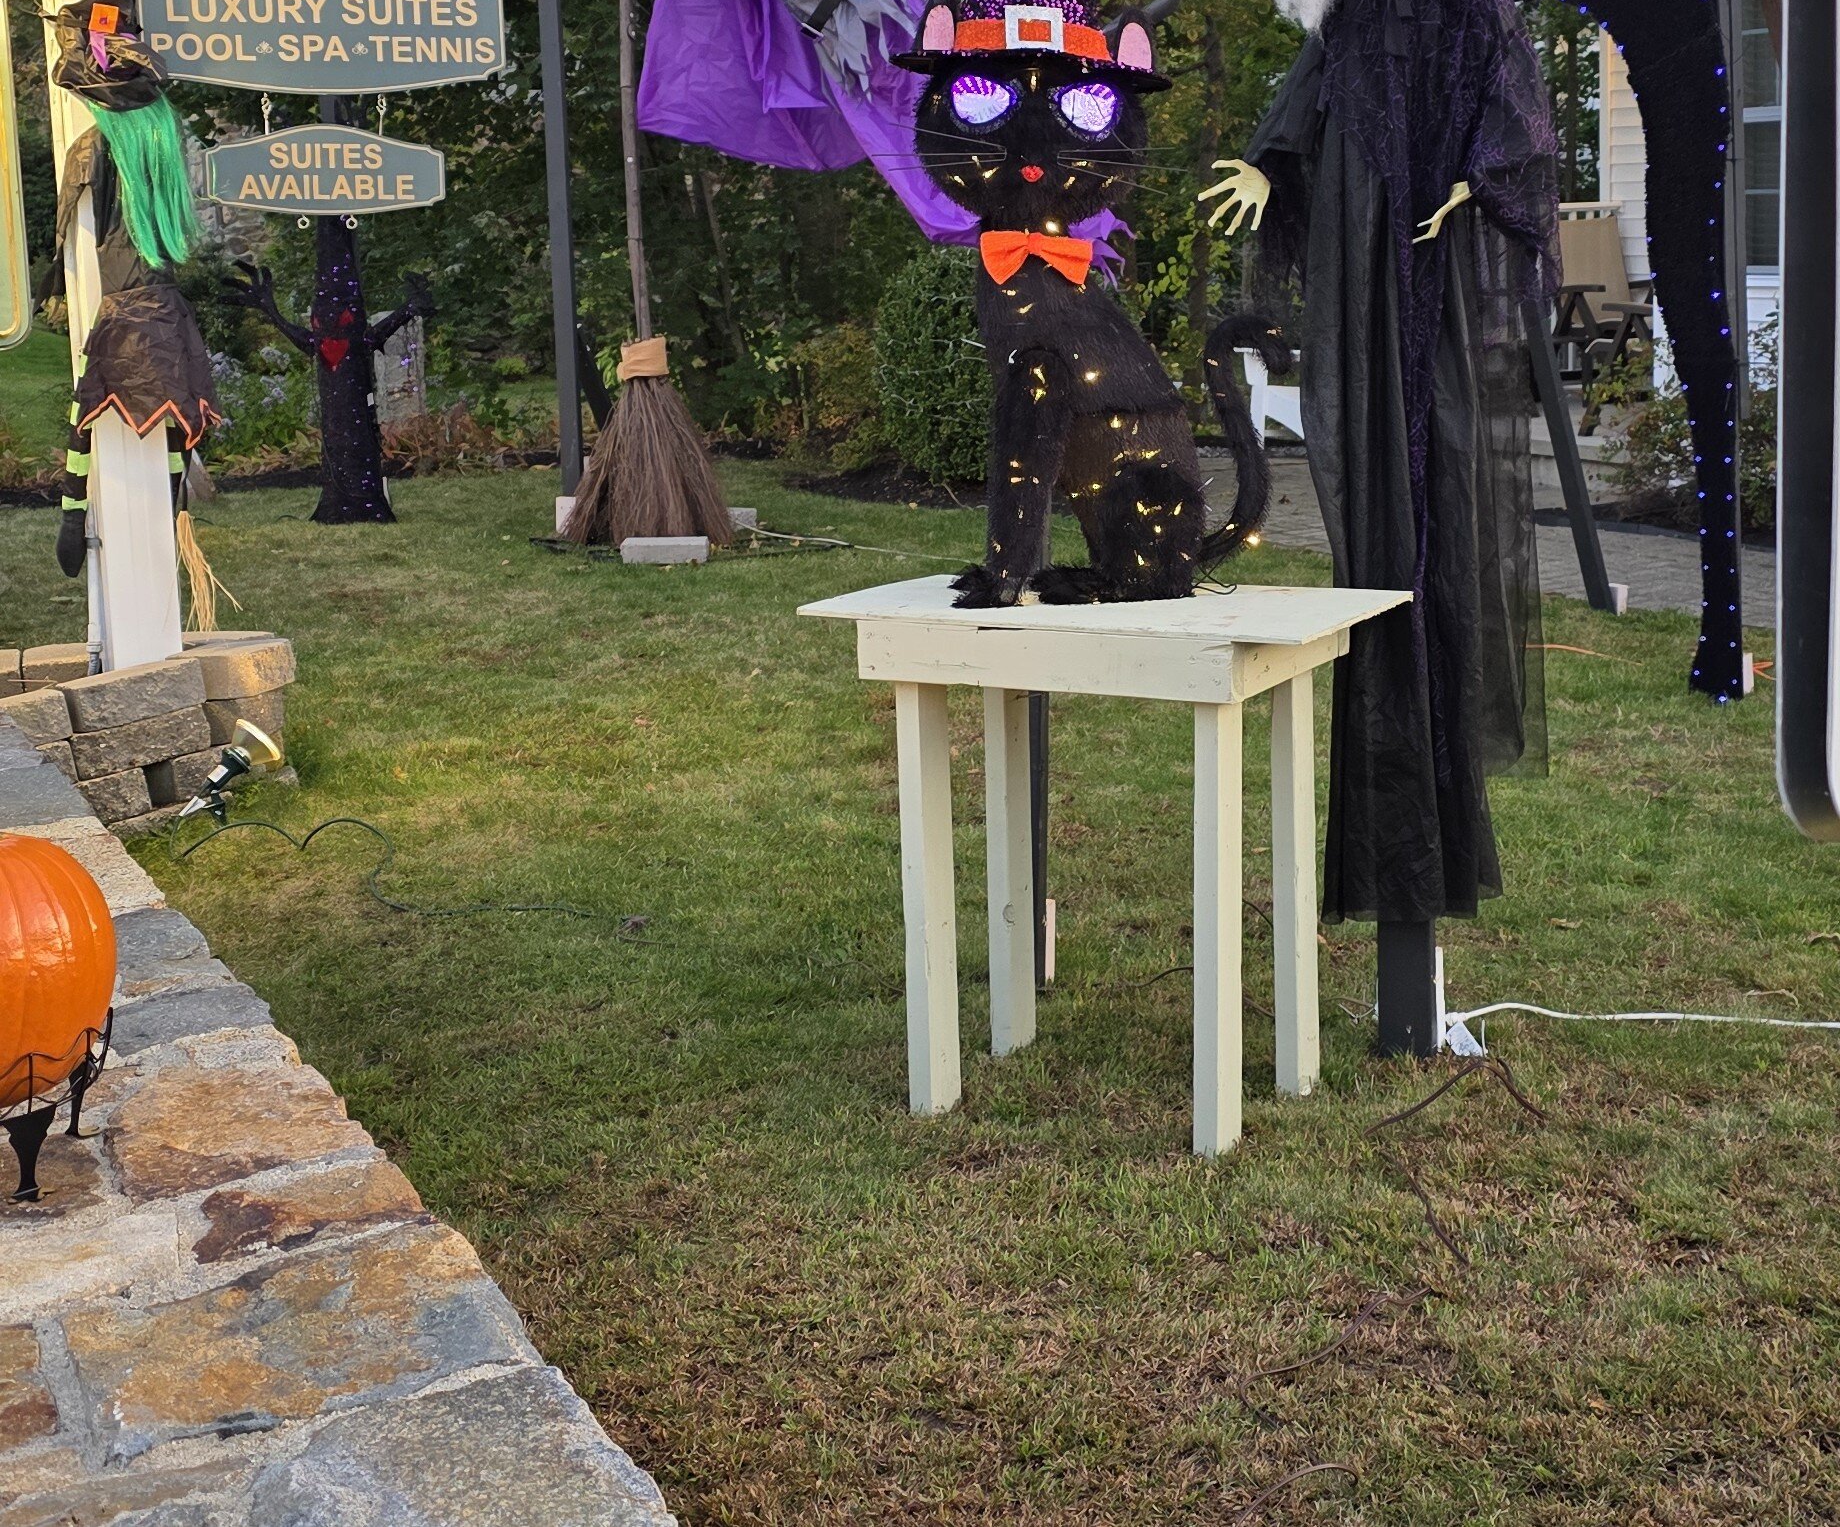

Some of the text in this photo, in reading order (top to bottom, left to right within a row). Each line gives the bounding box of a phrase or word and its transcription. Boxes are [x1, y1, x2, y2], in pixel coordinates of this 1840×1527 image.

[151, 33, 496, 64] POOL SPA TENNIS
[268, 142, 383, 170] SUITES
[238, 174, 416, 201] AVAILABLE
